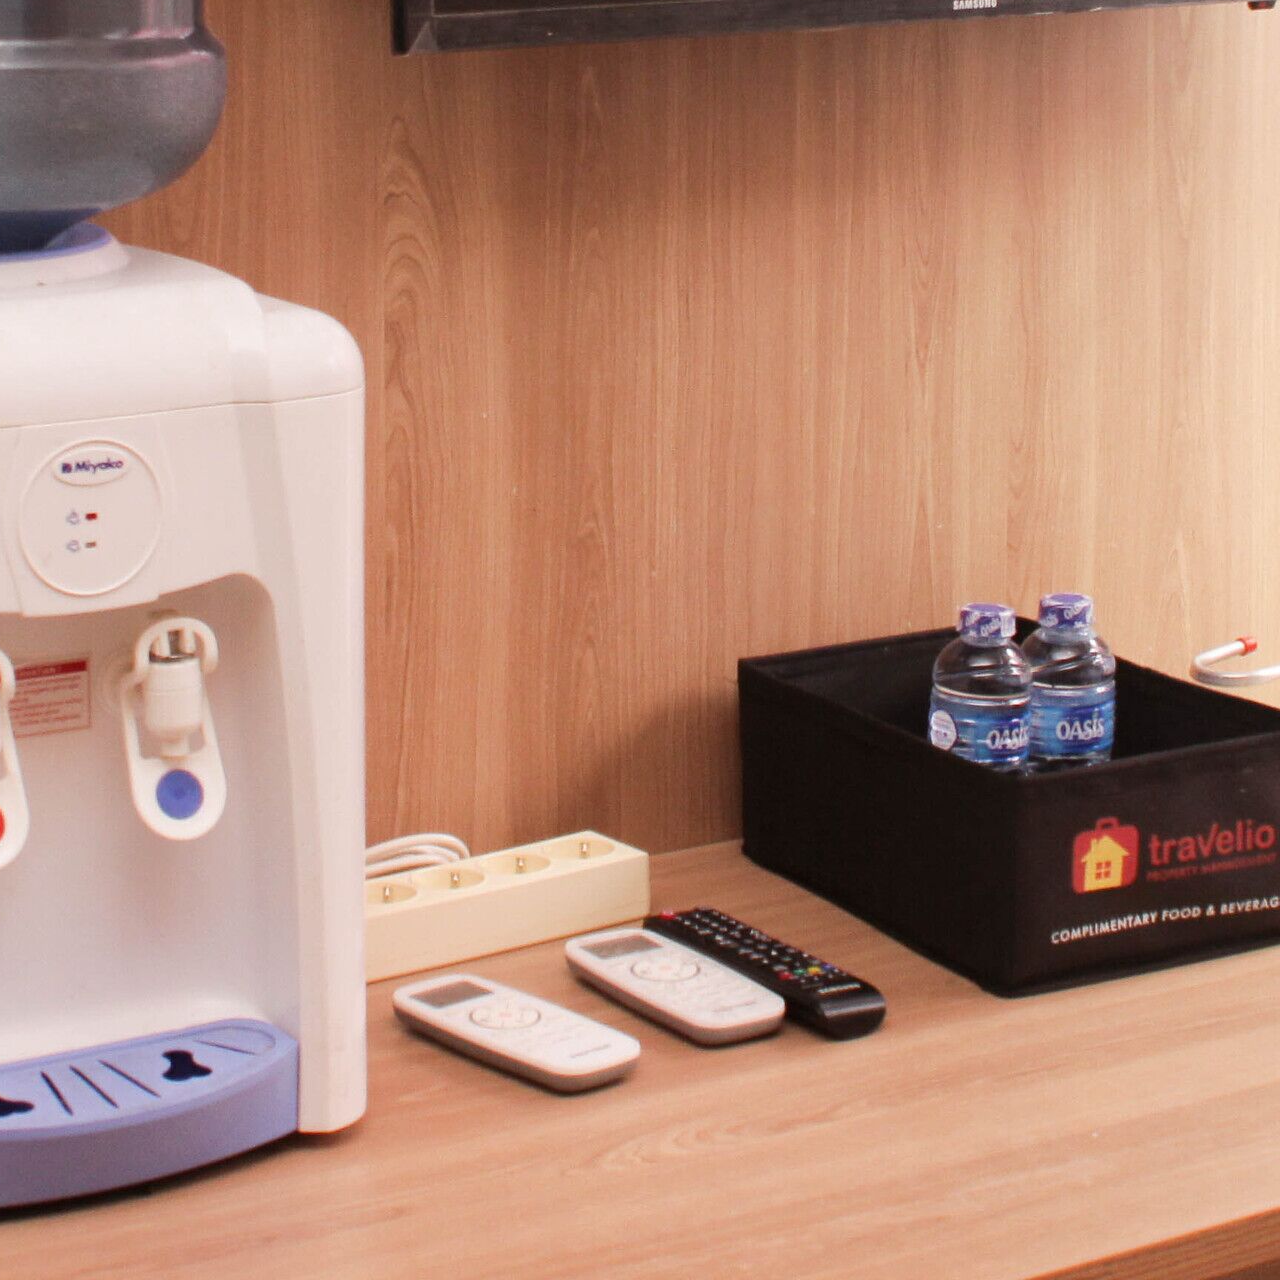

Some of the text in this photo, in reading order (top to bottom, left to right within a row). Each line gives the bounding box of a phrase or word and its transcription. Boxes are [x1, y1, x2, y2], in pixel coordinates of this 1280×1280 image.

[75, 457, 124, 476] Miyako
[1148, 819, 1277, 867] travelio
[1050, 911, 1158, 945] COMPLIMENTARY
[1161, 906, 1201, 923] FOOD
[1206, 904, 1216, 917] &
